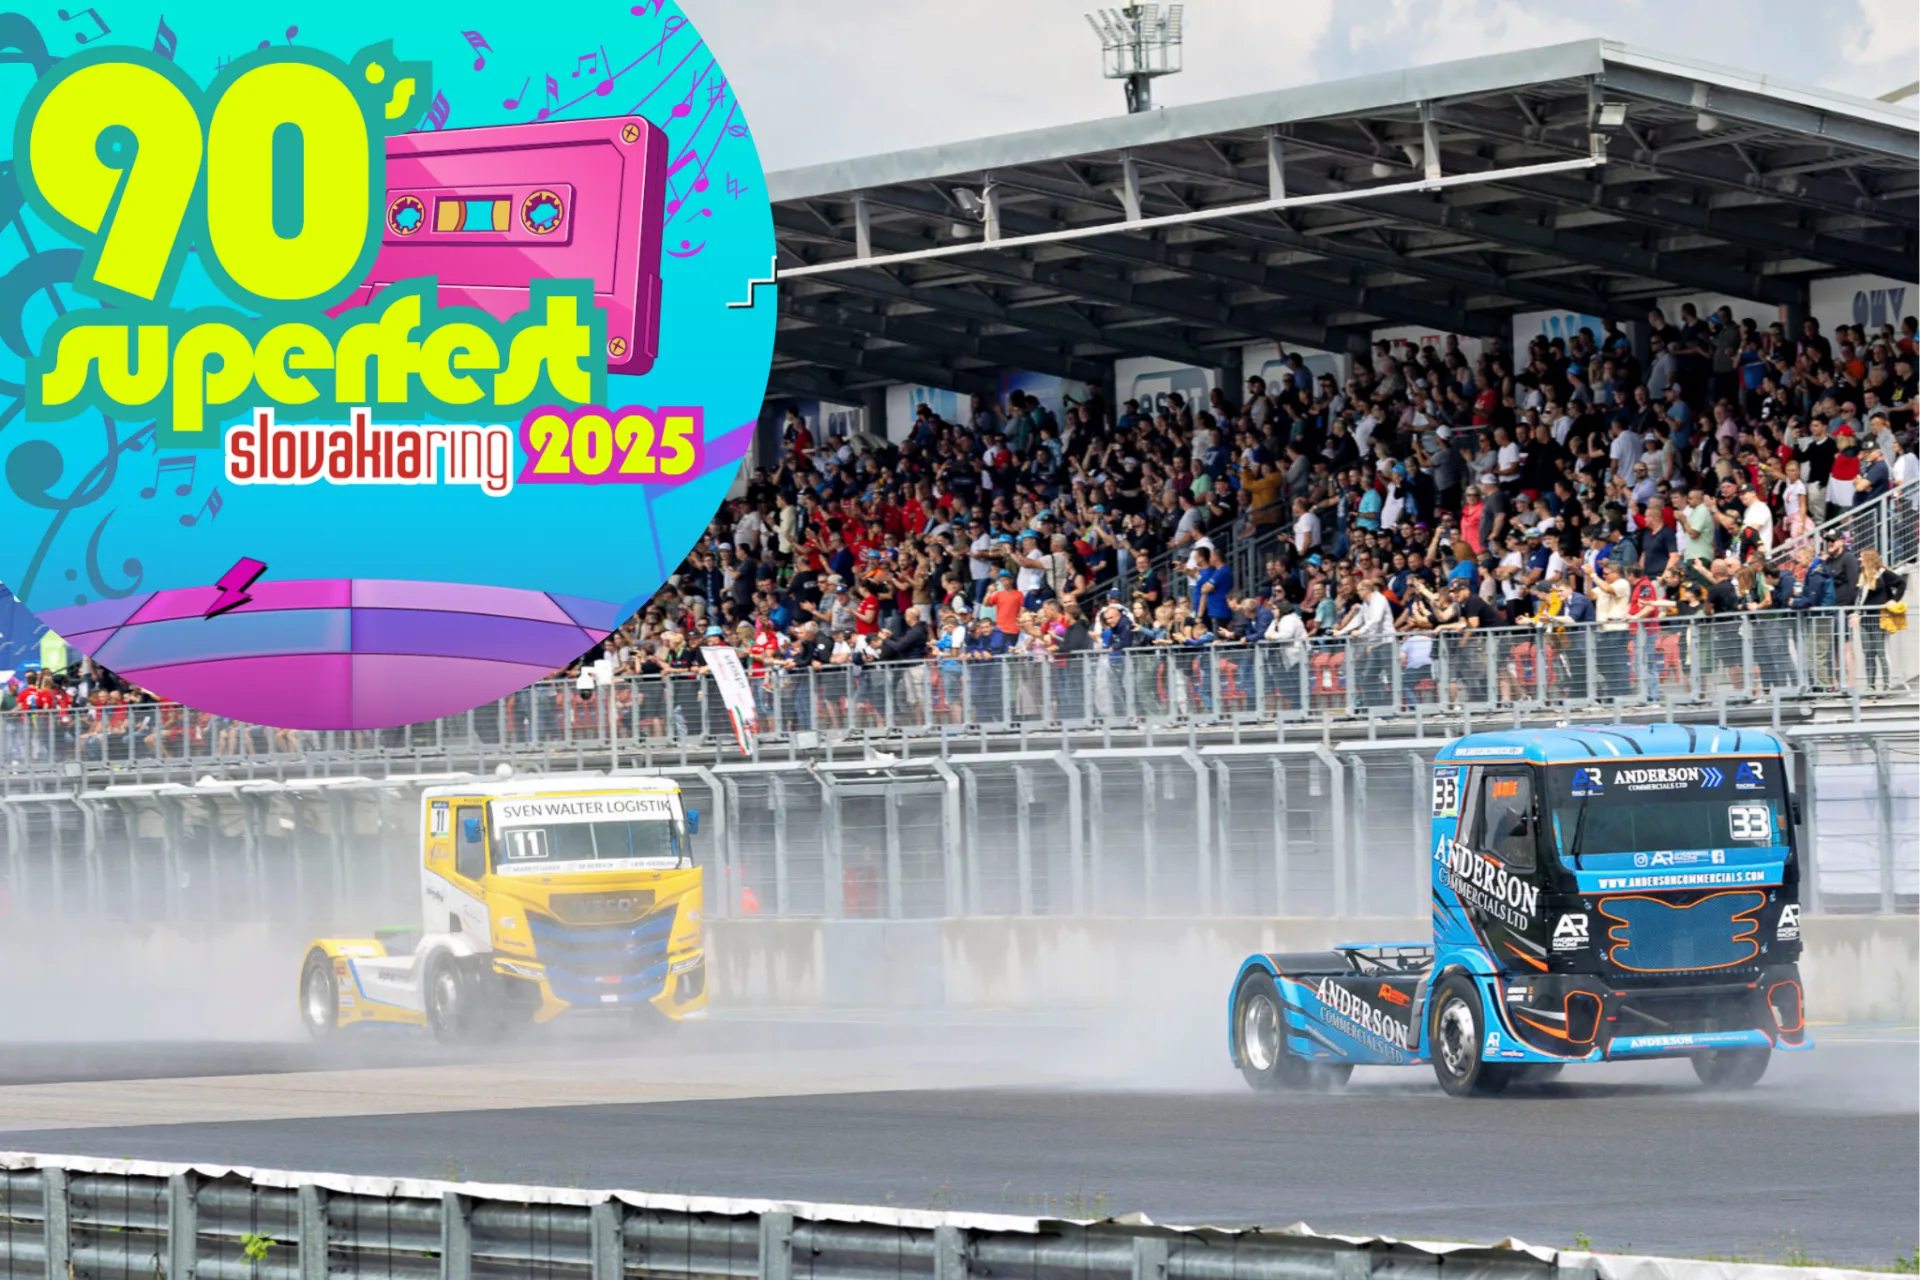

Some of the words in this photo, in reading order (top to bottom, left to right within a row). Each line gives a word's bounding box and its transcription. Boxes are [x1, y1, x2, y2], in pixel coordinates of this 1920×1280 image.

[1614, 767, 1699, 784] ANDERSON
[1628, 783, 1674, 791] COMMERCIALS
[1435, 779, 1456, 809] 33
[503, 805, 542, 818] SVEN
[544, 802, 604, 816] WALTER
[606, 799, 671, 813] LOGISTIK
[1731, 808, 1769, 837] 33
[514, 831, 540, 857] 11
[1434, 833, 1539, 917] ANDERSON
[1598, 871, 1765, 889] WWW.ANDERSONCOMMERCIALS.COM
[1439, 867, 1506, 920] COMMERCIALS
[1506, 906, 1528, 931] LTD
[1553, 914, 1589, 937] AR
[1315, 977, 1409, 1051] ANDERSON
[1320, 1006, 1383, 1054] COMMERCIALS
[1385, 1043, 1403, 1063] LTD
[1631, 1036, 1694, 1048] ANDERSON
